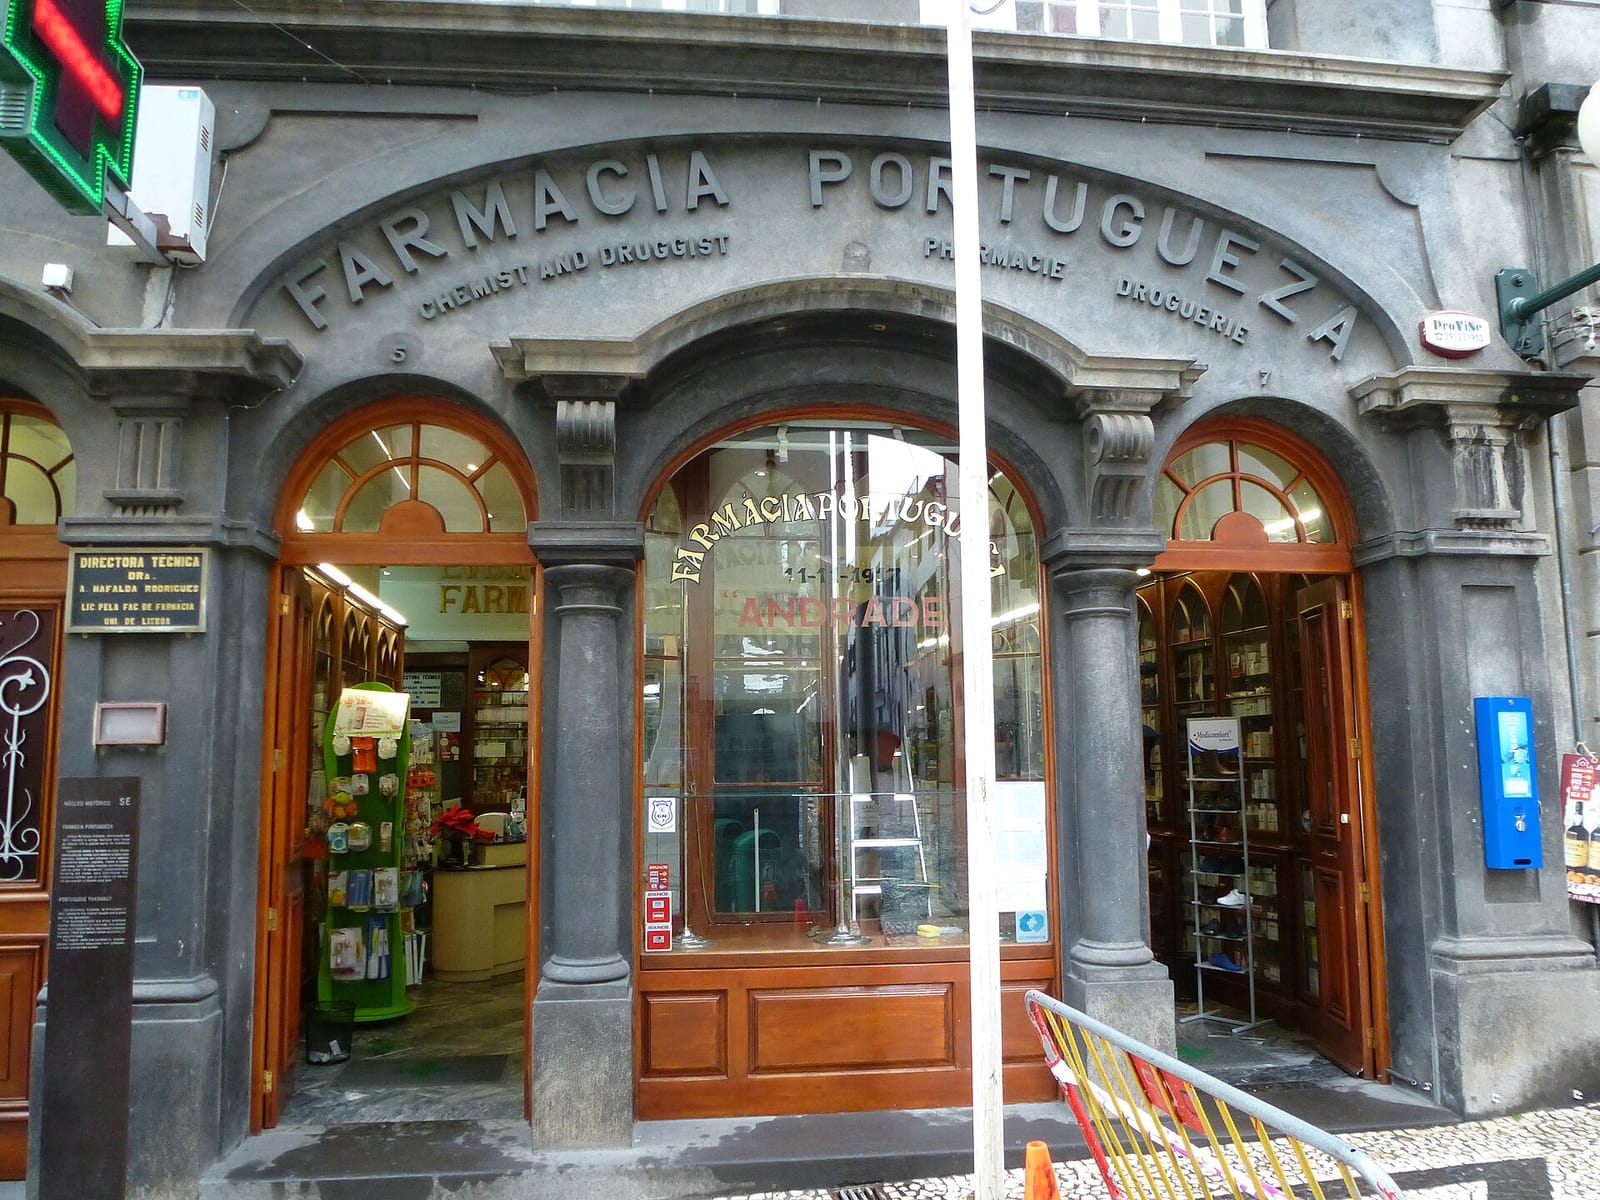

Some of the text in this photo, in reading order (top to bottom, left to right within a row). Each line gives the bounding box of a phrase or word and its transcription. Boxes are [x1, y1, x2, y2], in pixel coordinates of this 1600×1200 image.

[284, 149, 1358, 362] FARMACIA PORTUGUEZA
[923, 236, 1068, 281] PHRMACIE
[417, 234, 730, 321] CHEMIST AND DRUGGIST
[1115, 276, 1250, 345] DROGUERIE
[1259, 368, 1273, 387] 7
[670, 491, 816, 584] FARMÁCIA
[80, 556, 144, 569] DIRECTORA
[80, 603, 95, 612] LIC
[97, 603, 119, 612] PELA
[122, 603, 139, 612] FAC
[439, 585, 529, 614] FARM
[124, 617, 136, 626] DE
[119, 797, 131, 806] SE
